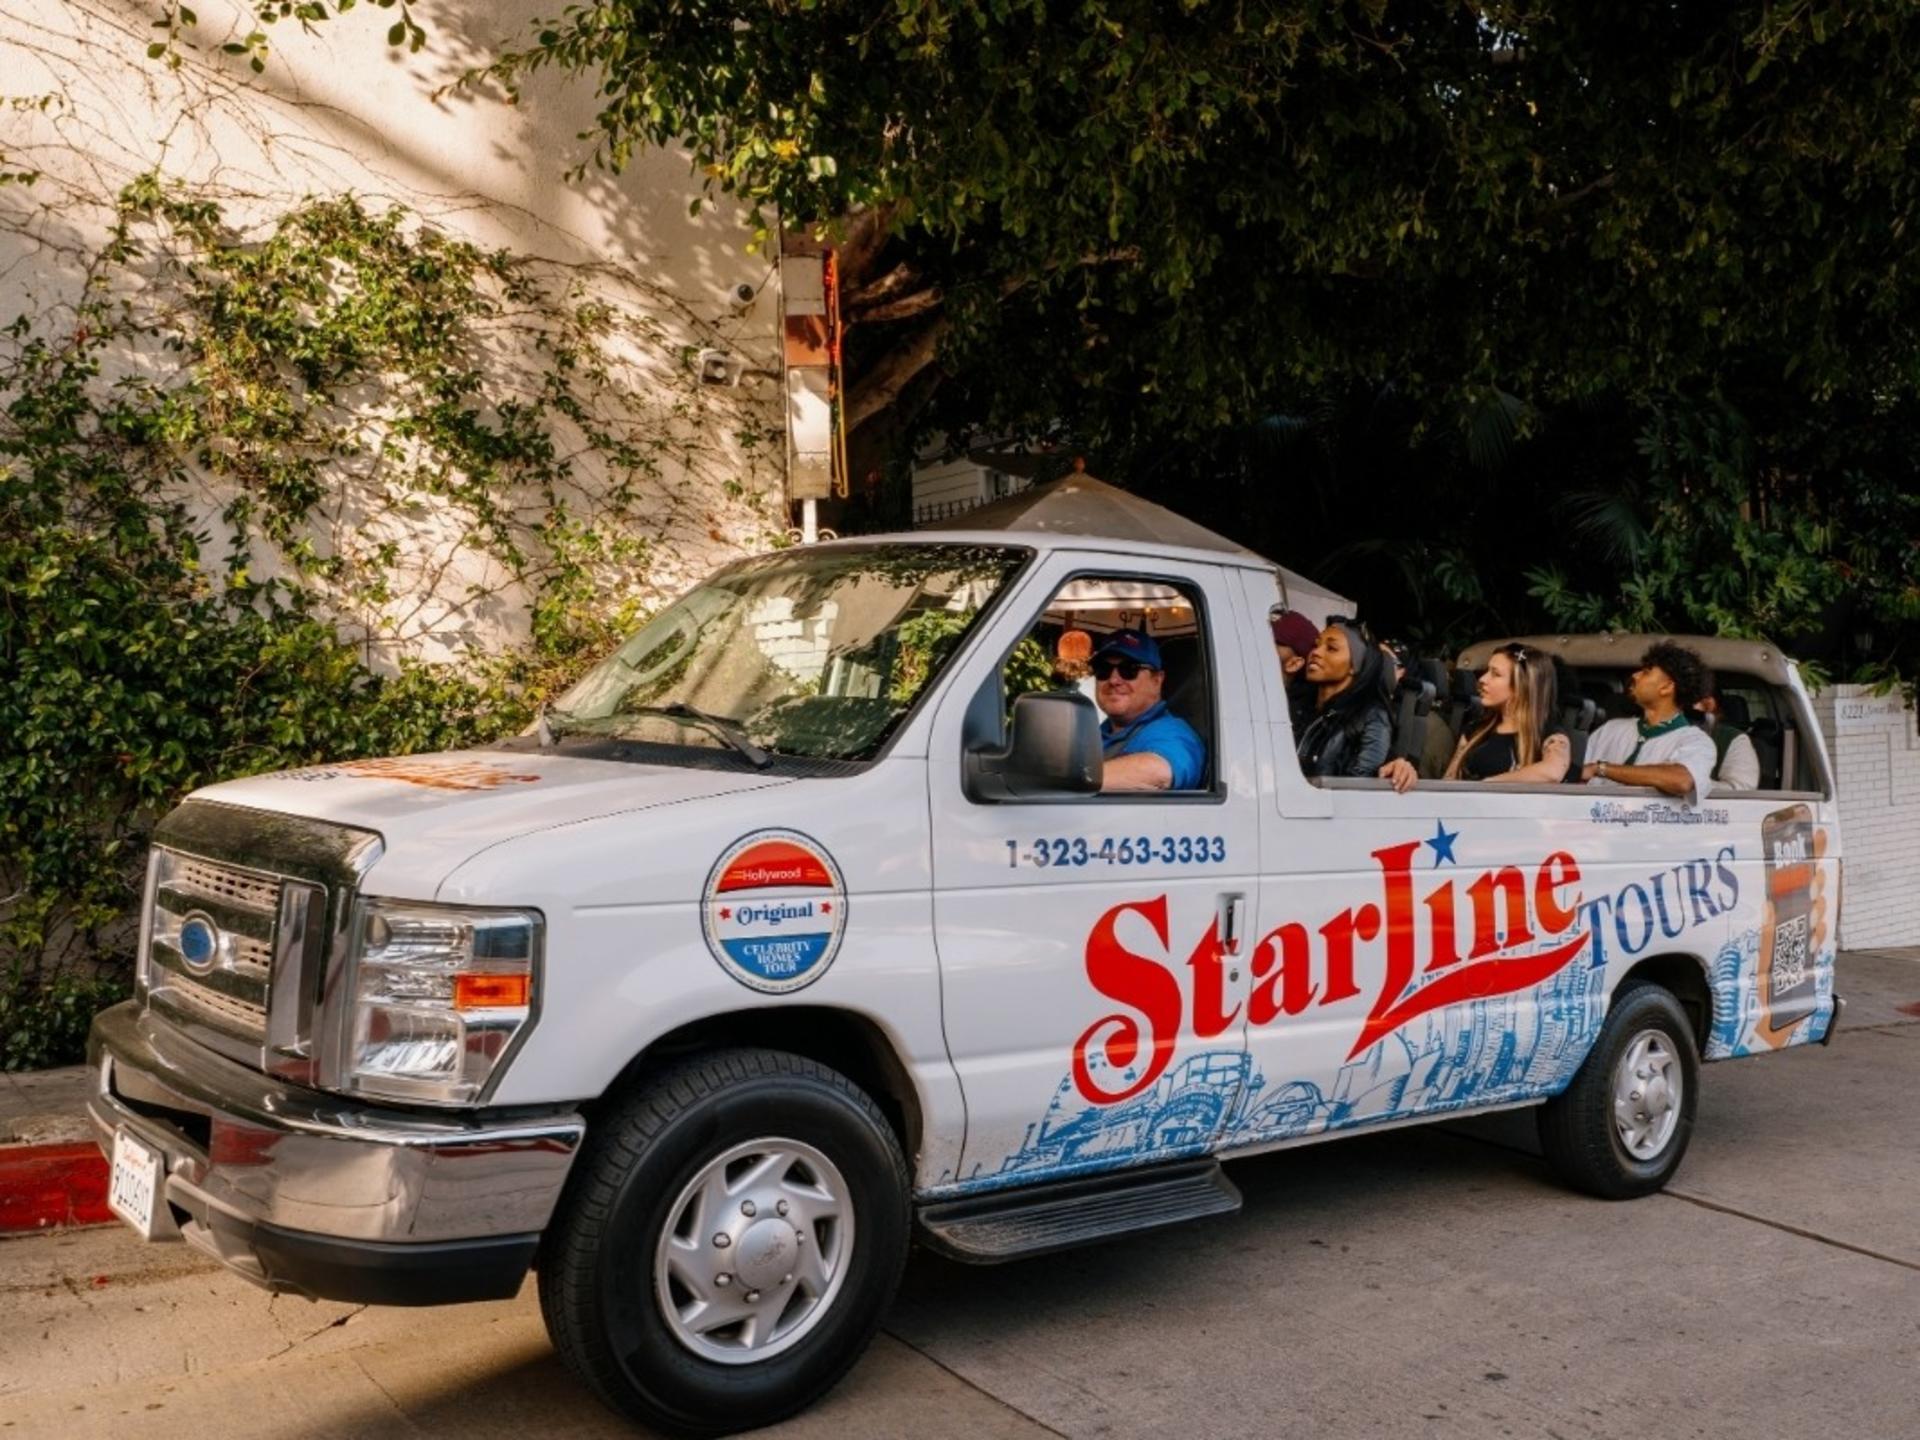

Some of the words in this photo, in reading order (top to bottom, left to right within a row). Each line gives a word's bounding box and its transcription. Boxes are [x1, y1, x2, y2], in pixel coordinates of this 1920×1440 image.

[1006, 836, 1226, 868] 1-323-463-3333
[742, 867, 801, 882] Hollywood
[736, 902, 813, 925] Original
[1577, 844, 1740, 971] TOURS
[743, 940, 811, 956] CELEBRITY
[763, 961, 797, 975] TOUR
